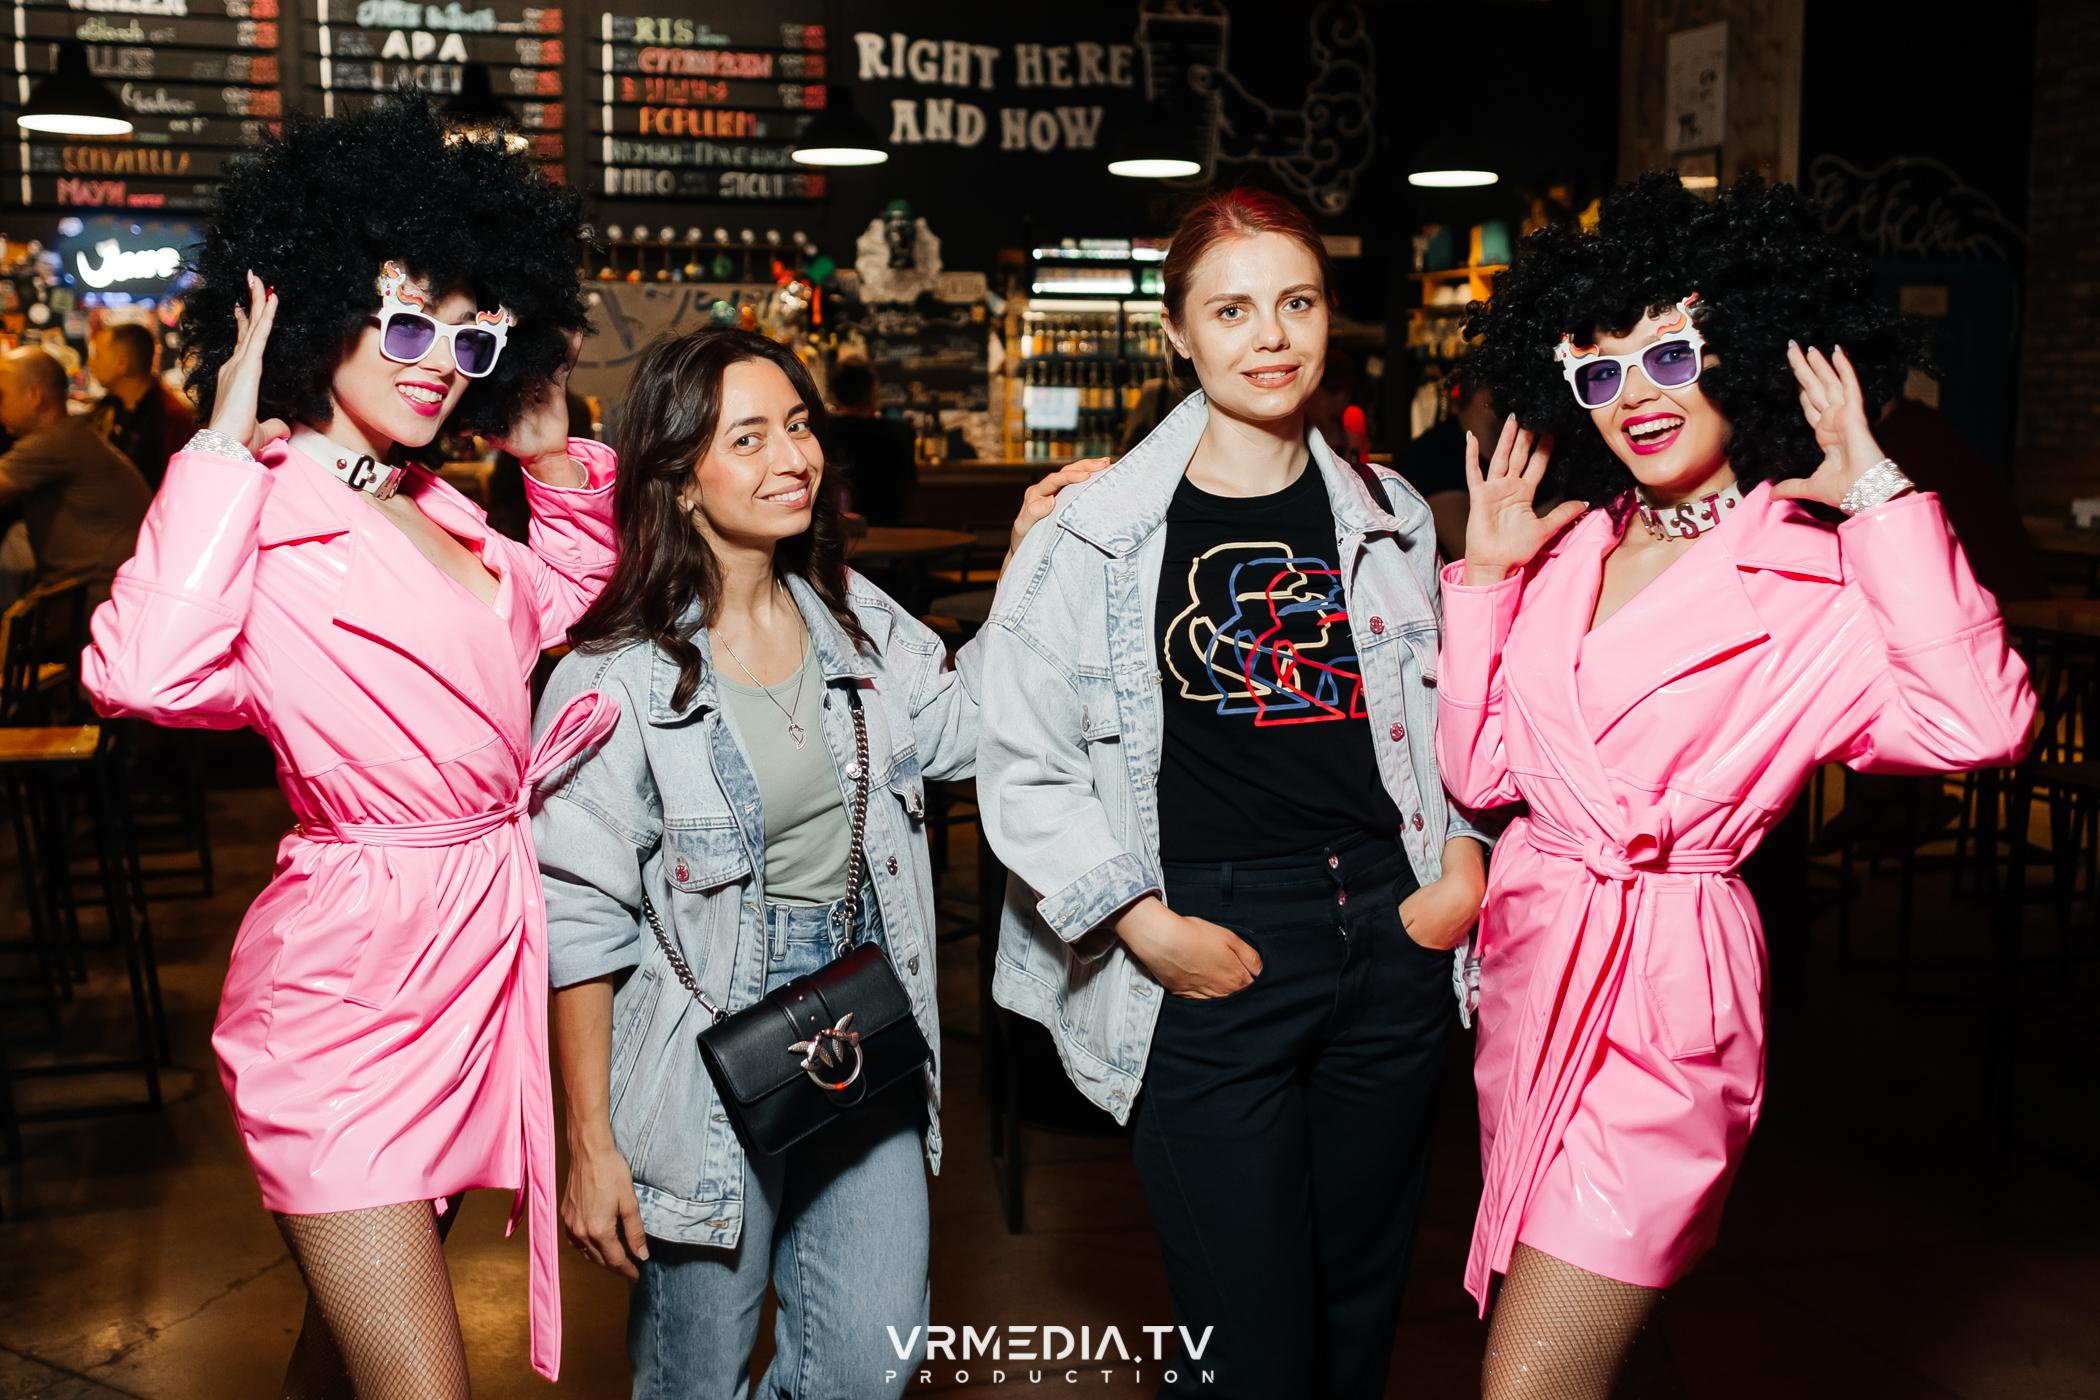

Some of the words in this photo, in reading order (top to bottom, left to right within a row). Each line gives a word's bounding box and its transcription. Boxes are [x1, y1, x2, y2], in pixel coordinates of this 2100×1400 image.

[854, 33, 1000, 89] RIGHT
[1014, 42, 1134, 87] HERE
[889, 99, 986, 147] AND
[1001, 106, 1104, 152] NOW
